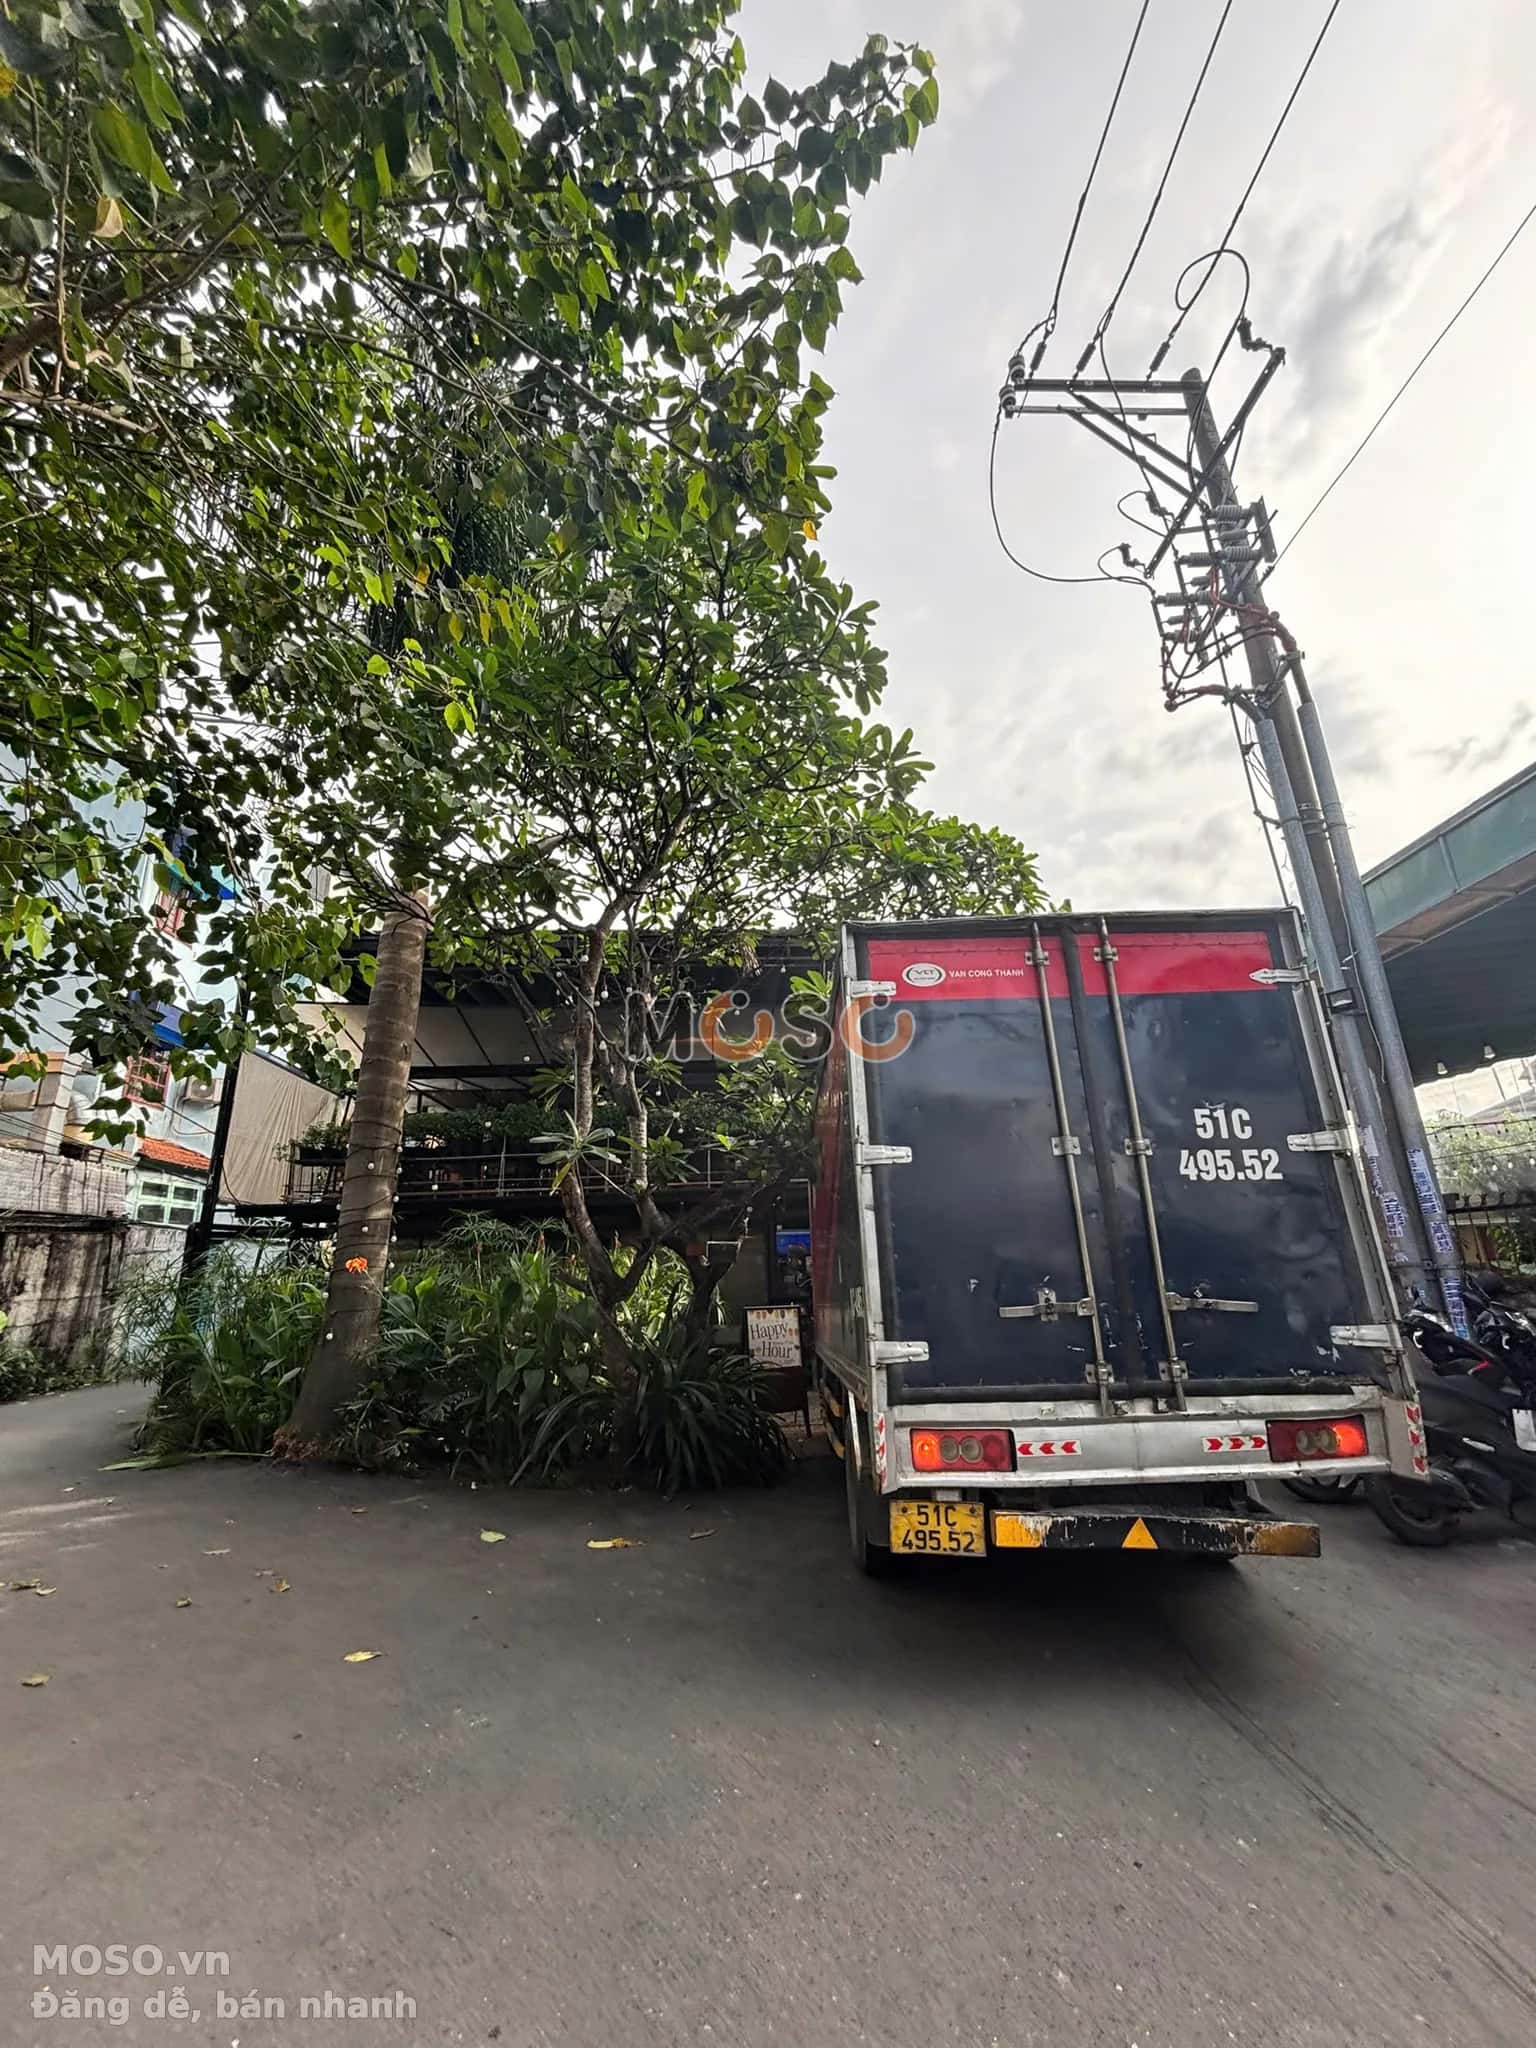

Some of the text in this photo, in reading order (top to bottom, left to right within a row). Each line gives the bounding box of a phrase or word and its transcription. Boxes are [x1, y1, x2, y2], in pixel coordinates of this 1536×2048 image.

[949, 967, 1024, 978] VAN CONG THANH
[1193, 1107, 1253, 1139] 51C
[1179, 1148, 1284, 1181] 495.52
[750, 1322, 787, 1340] Happy
[761, 1340, 793, 1359] Hour
[916, 1504, 957, 1527] 51C
[902, 1529, 976, 1553] 495.52
